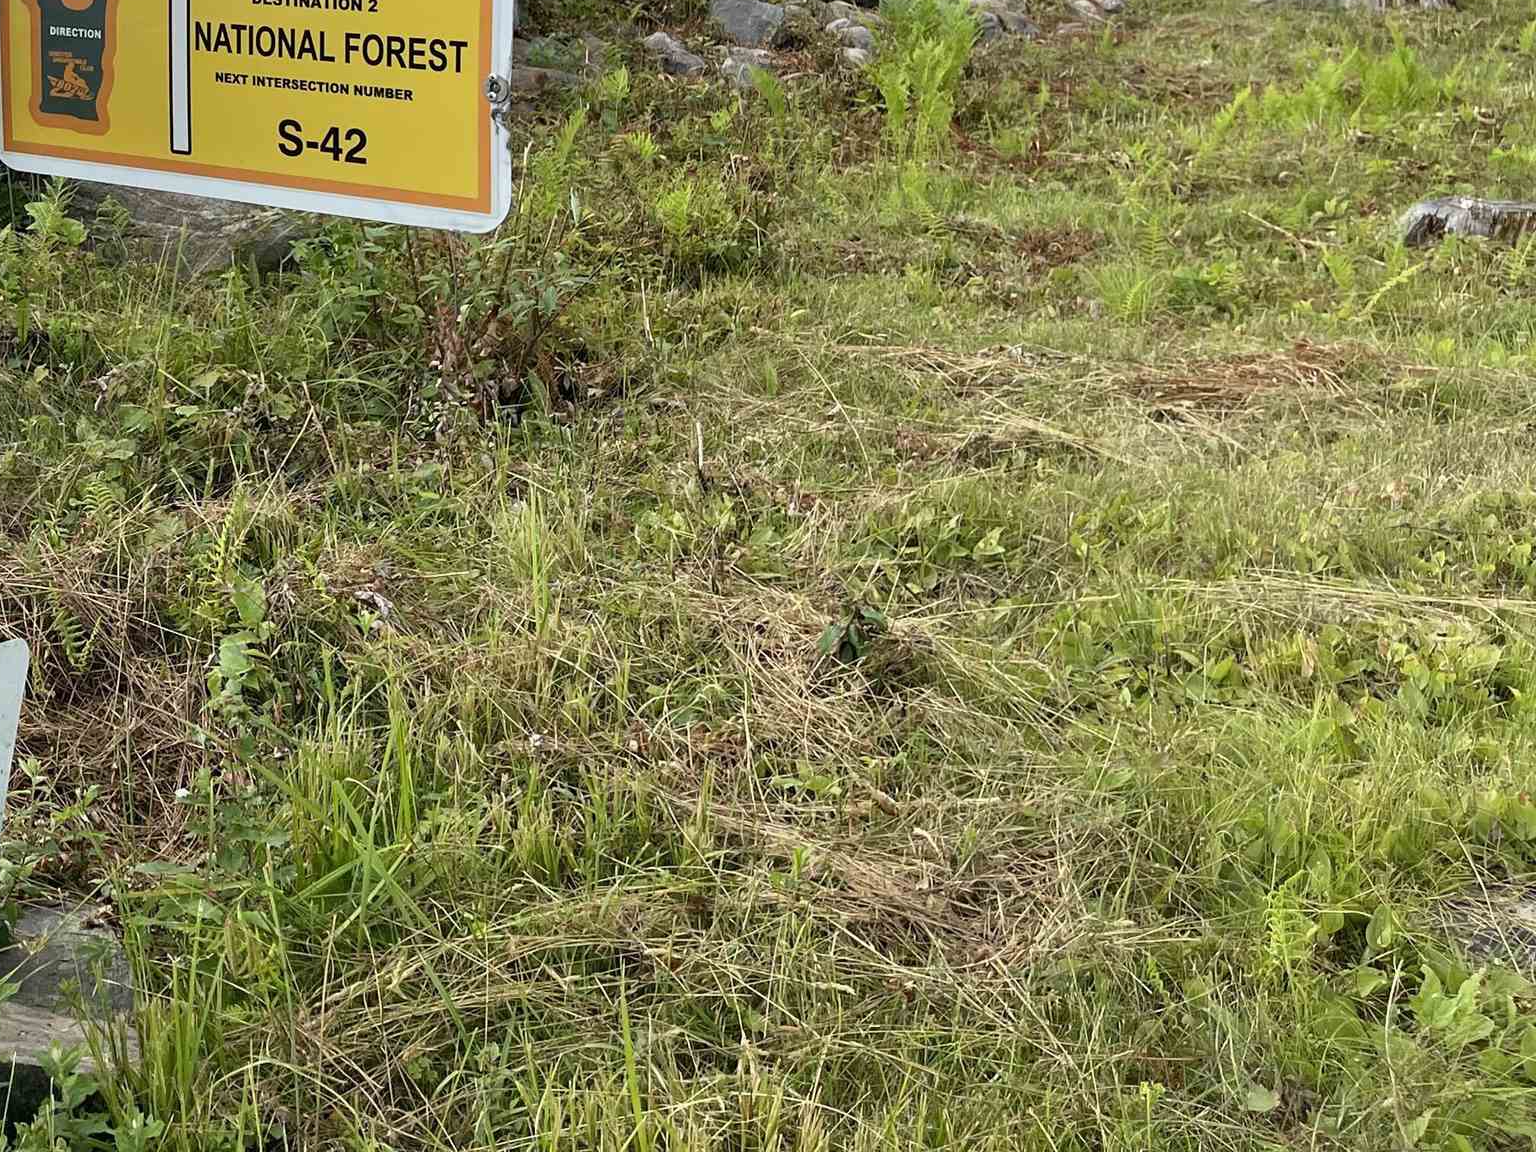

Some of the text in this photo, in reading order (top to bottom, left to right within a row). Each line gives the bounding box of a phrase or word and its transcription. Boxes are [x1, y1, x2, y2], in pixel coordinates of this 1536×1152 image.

[368, 0, 378, 12] 2
[49, 26, 102, 39] DIRECTION
[194, 21, 468, 73] NATIONAL FOREST
[215, 71, 413, 101] NEXT INTERSECTION NUMBER
[278, 119, 368, 165] S-42
